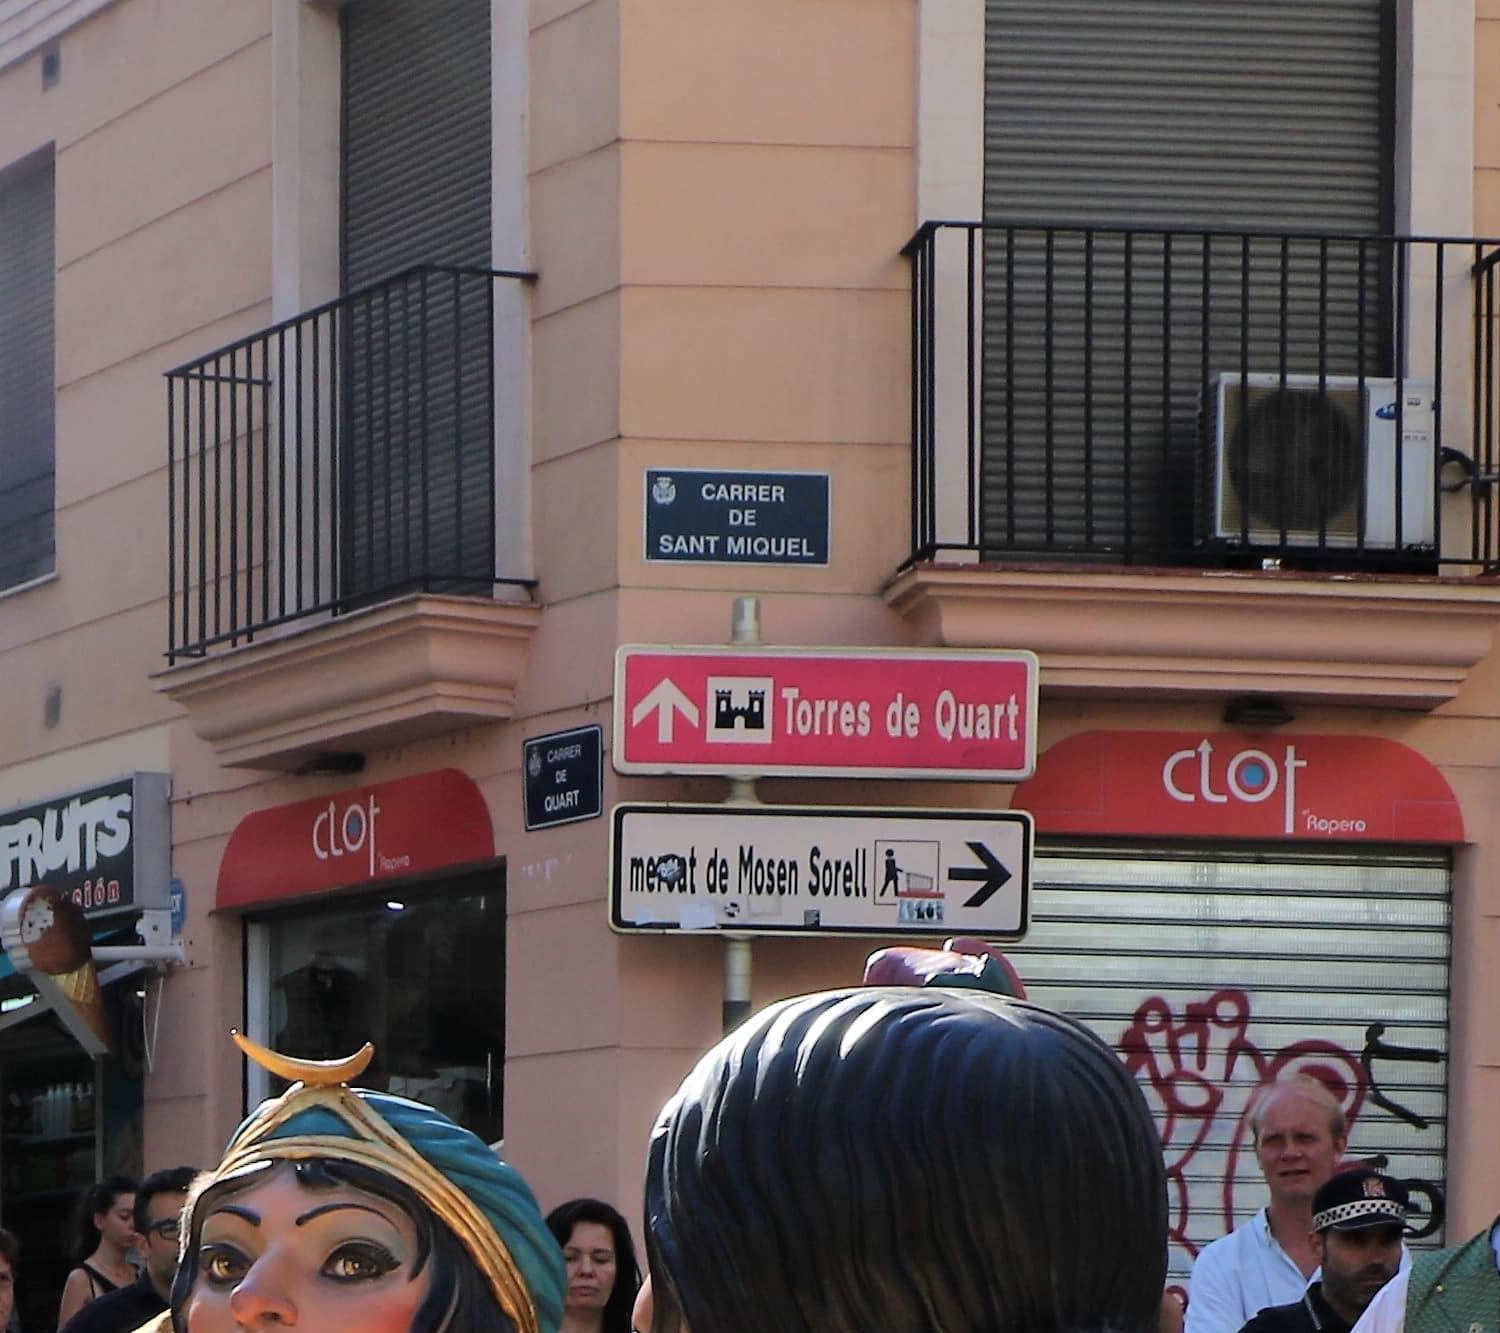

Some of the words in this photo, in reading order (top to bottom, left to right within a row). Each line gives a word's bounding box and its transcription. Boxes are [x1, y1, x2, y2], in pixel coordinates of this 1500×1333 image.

[701, 483, 785, 502] CARRER
[729, 509, 756, 526] DE
[659, 534, 720, 554] SANT
[727, 536, 815, 557] MIQUEL
[782, 687, 871, 737] Torres
[886, 692, 920, 739] de
[935, 690, 1019, 742] Quart
[547, 744, 581, 763] CARRER
[555, 769, 567, 783] DE
[544, 790, 579, 812] QUART
[1307, 814, 1366, 835] Ropero
[706, 847, 729, 894] de
[738, 845, 798, 897] Mosen
[808, 846, 867, 897] Sorell
